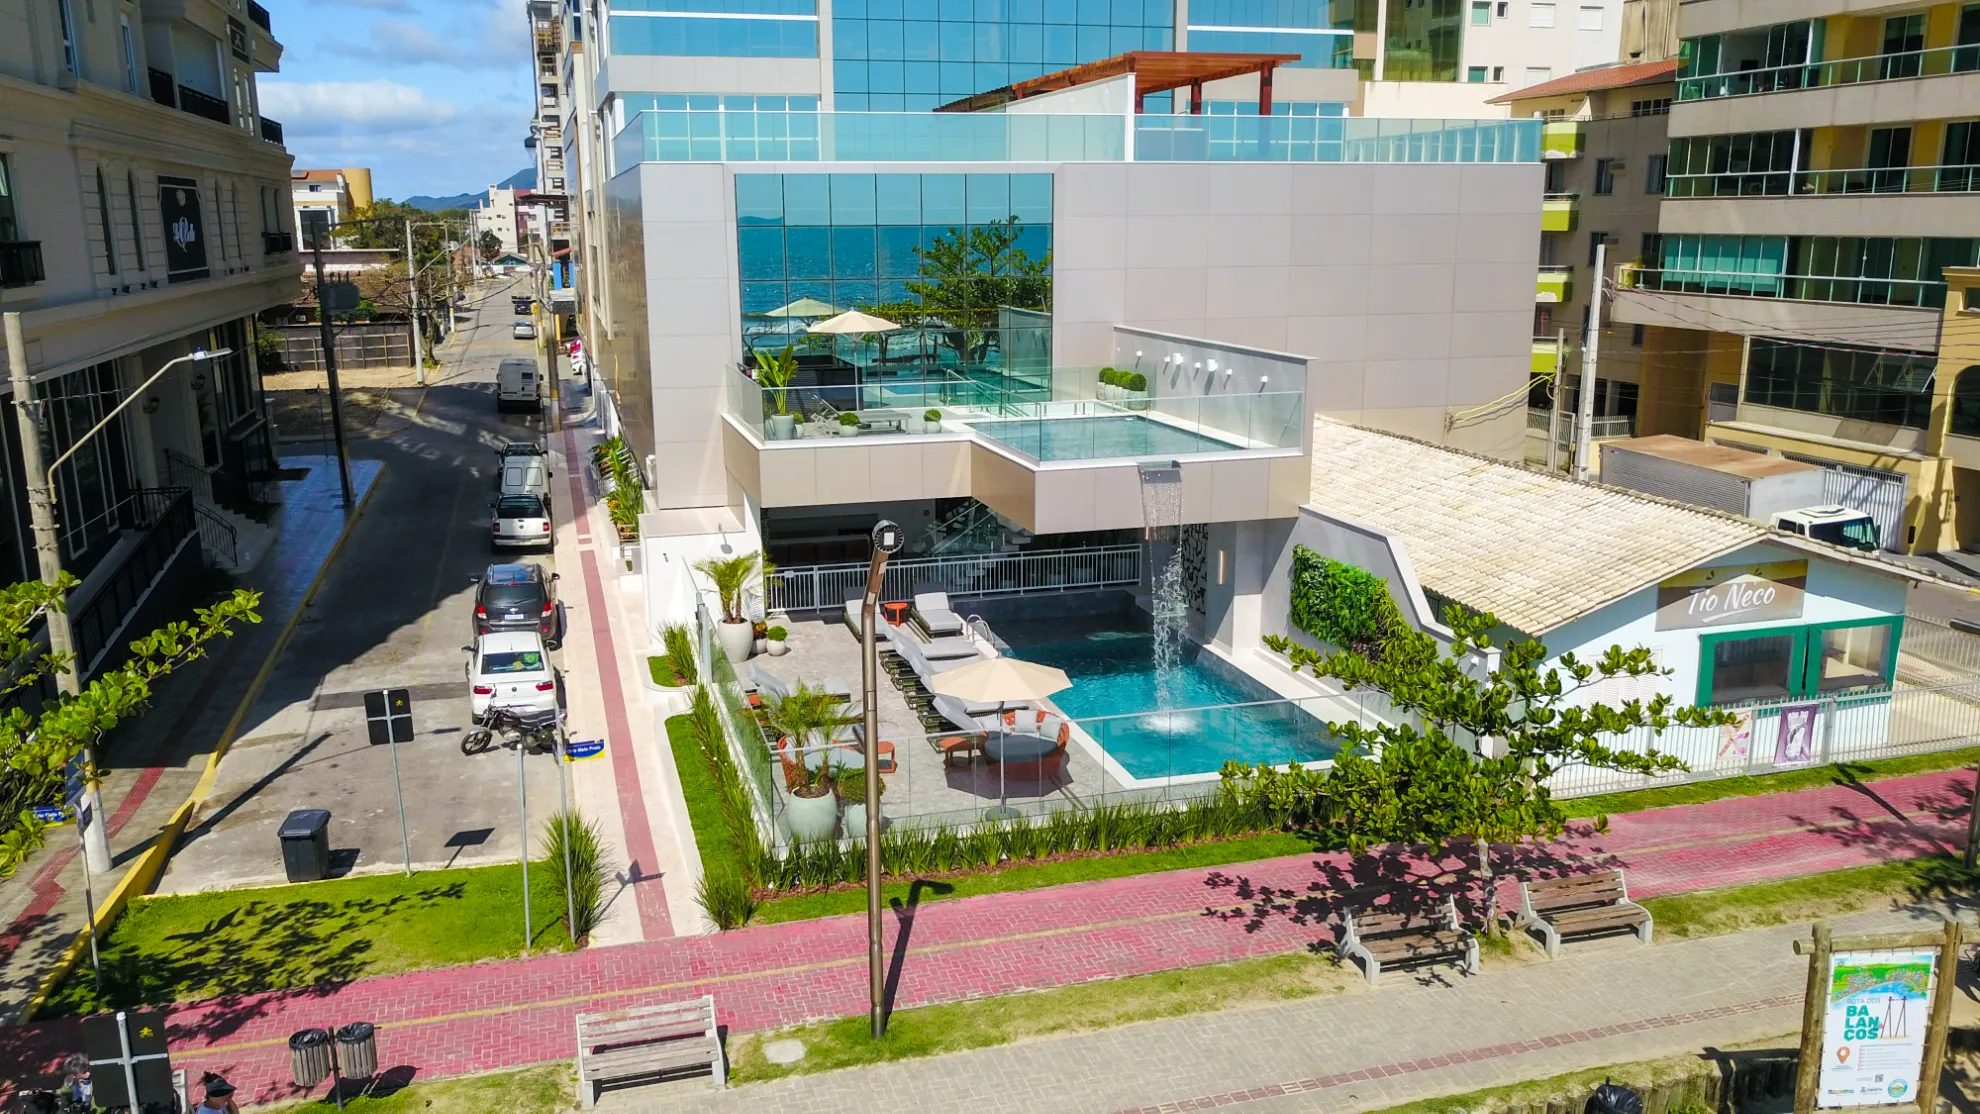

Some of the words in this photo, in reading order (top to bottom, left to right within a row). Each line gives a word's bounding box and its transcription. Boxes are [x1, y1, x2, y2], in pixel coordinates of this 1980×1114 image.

[1688, 588, 1718, 615] Tio
[1724, 583, 1776, 610] Neco
[1846, 1005, 1869, 1017] BA
[1844, 1016, 1879, 1029] LAN
